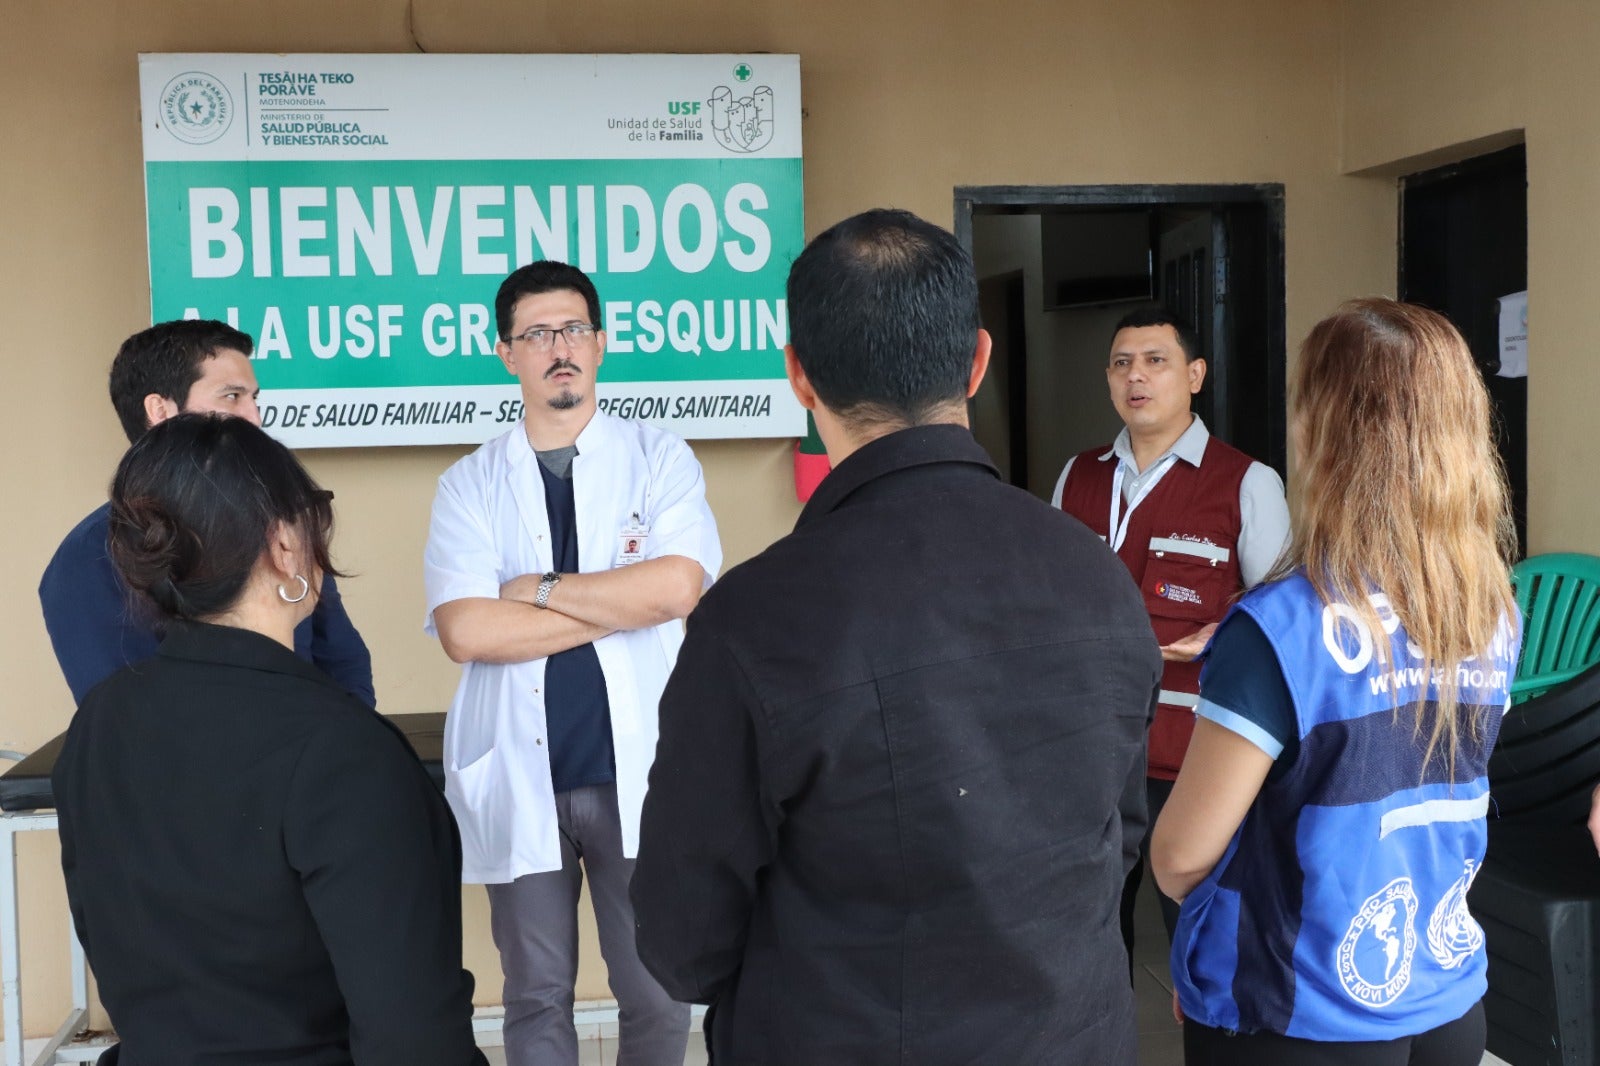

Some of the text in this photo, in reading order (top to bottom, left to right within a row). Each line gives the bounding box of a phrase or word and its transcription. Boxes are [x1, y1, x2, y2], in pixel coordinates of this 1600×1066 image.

[187, 79, 204, 87] DEL
[298, 73, 318, 84] HA
[320, 73, 354, 84] TEKO
[260, 98, 326, 106] MOTENONDEHA
[668, 101, 701, 115] USF
[261, 113, 325, 121] MINISTERIO DE
[608, 117, 702, 129] Unidad de Salud
[261, 120, 361, 134] SALUD PÚBLICA
[262, 134, 389, 146] Y BIENESTAR SOCIAL
[628, 129, 703, 141] de la Familia
[188, 182, 771, 278] BIENVENIDOS
[307, 304, 404, 359] USF
[421, 302, 499, 357] GR
[605, 299, 788, 356] ESQUIN
[281, 404, 311, 428] DE
[312, 403, 378, 427] SALUD
[382, 400, 476, 425] FAMILIAR
[672, 394, 771, 418] SANITARIA
[1355, 898, 1380, 929] PRO
[1342, 942, 1352, 973] OPS
[1351, 981, 1382, 1002] NOVI
